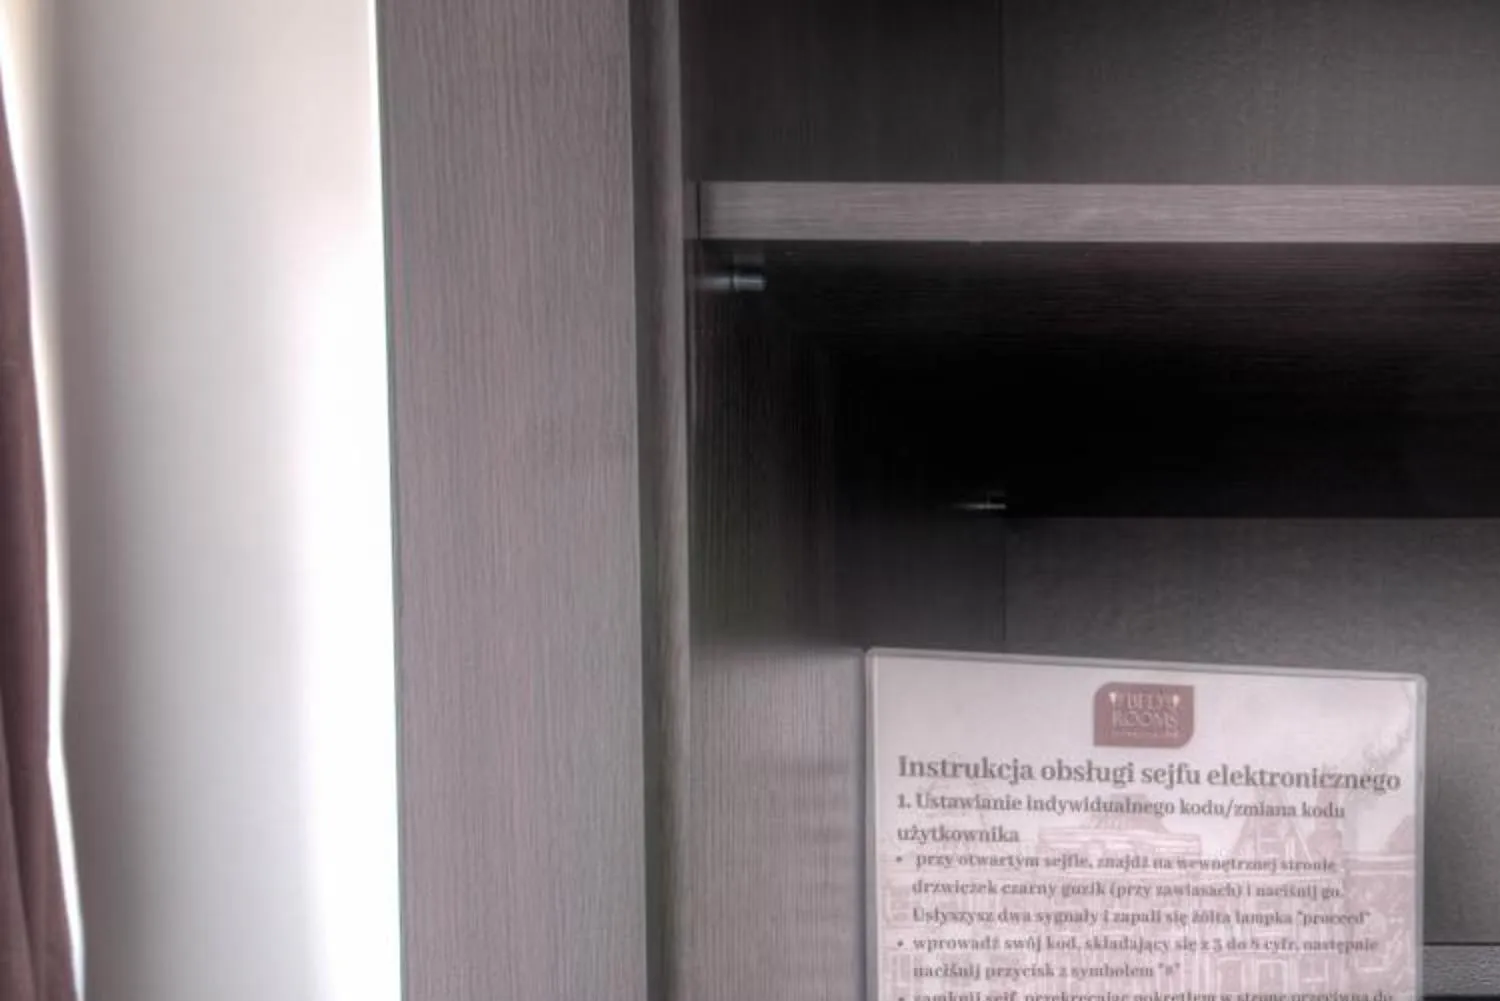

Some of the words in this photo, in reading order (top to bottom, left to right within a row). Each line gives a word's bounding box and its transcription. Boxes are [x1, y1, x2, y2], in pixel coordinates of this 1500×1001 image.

[898, 755, 1033, 785] Instrukcja
[1041, 759, 1135, 787] obsługi
[1142, 763, 1200, 789] sejfu
[1207, 764, 1401, 791] elektronicznego
[897, 794, 911, 809] 1.
[916, 793, 1023, 811] Ustawianie
[1027, 795, 1174, 816] indywidualnego
[1180, 798, 1297, 819] kodu/zmiana
[1302, 801, 1345, 818] kodu
[897, 824, 1020, 844] użytkownika
[916, 854, 952, 871] przy
[958, 854, 1040, 870] otwartym
[1153, 857, 1172, 869] na
[1177, 856, 1277, 873] wewnętrznej
[1280, 857, 1336, 872] stronie
[912, 880, 998, 895] drzwiczek
[1001, 882, 1056, 899] czarny
[1061, 881, 1105, 898] guzik
[1109, 881, 1150, 899] (przy
[1156, 883, 1242, 899] zawiasach)
[1256, 883, 1317, 901] naciśnij
[912, 907, 993, 926] Usłyszysz
[998, 907, 1031, 922] dwa
[1035, 907, 1097, 925] sygnały
[1103, 908, 1109, 922] i
[1113, 908, 1161, 926] zapali
[1166, 909, 1188, 926] się
[1235, 909, 1293, 926] lampka
[913, 936, 1000, 952] wprowadź
[1004, 936, 1041, 953] swój
[1085, 937, 1169, 954] składający
[1175, 937, 1197, 953] się
[1227, 938, 1247, 951] do
[1303, 938, 1378, 954] następnie
[913, 963, 980, 981] naciśnij
[985, 963, 1055, 981] przycisk
[1071, 963, 1154, 981] symbolem
